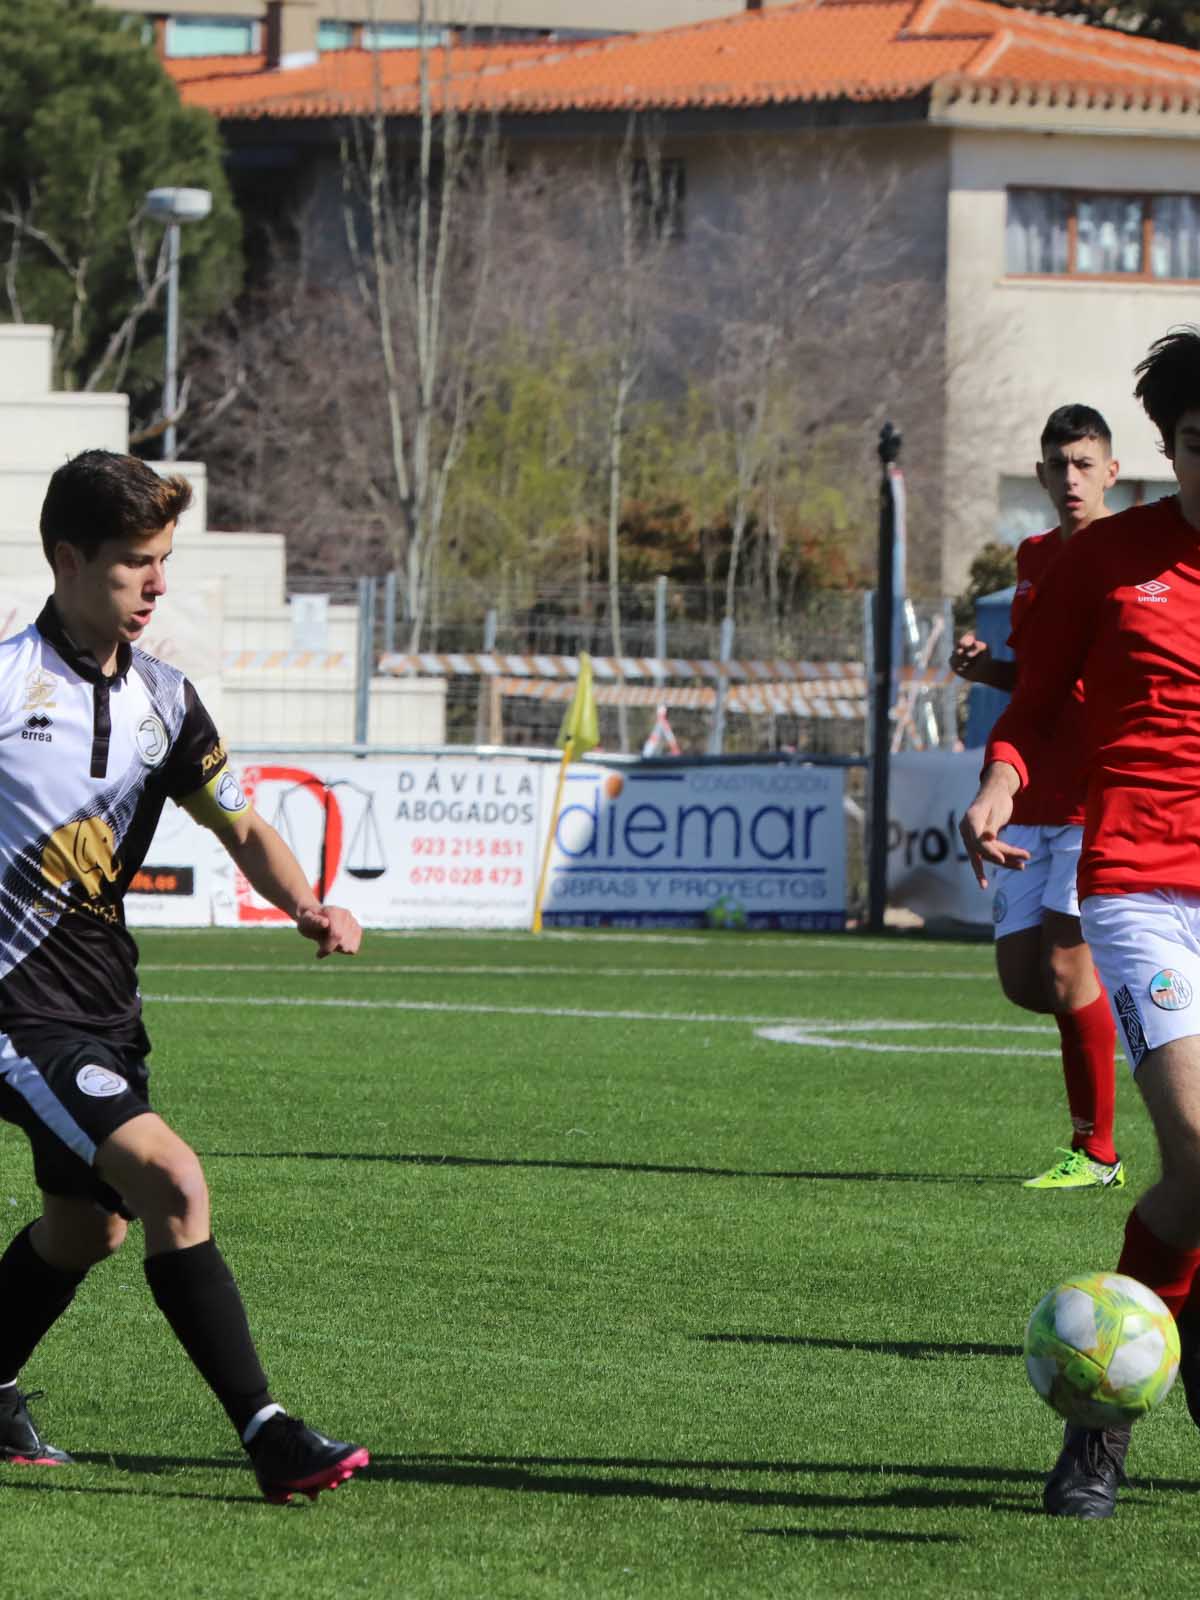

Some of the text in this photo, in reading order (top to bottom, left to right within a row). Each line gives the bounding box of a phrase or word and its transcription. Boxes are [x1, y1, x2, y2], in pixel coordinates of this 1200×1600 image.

[1137, 595, 1168, 603] umbro
[22, 730, 52, 742] errea
[397, 767, 533, 795] DÁVILA
[396, 800, 534, 824] ABOGADOS
[556, 777, 827, 861] diemar
[411, 836, 523, 857] 923 215 851
[410, 866, 523, 886] 670 028 473
[553, 876, 827, 899] OBRAS Y PROYECTOS
